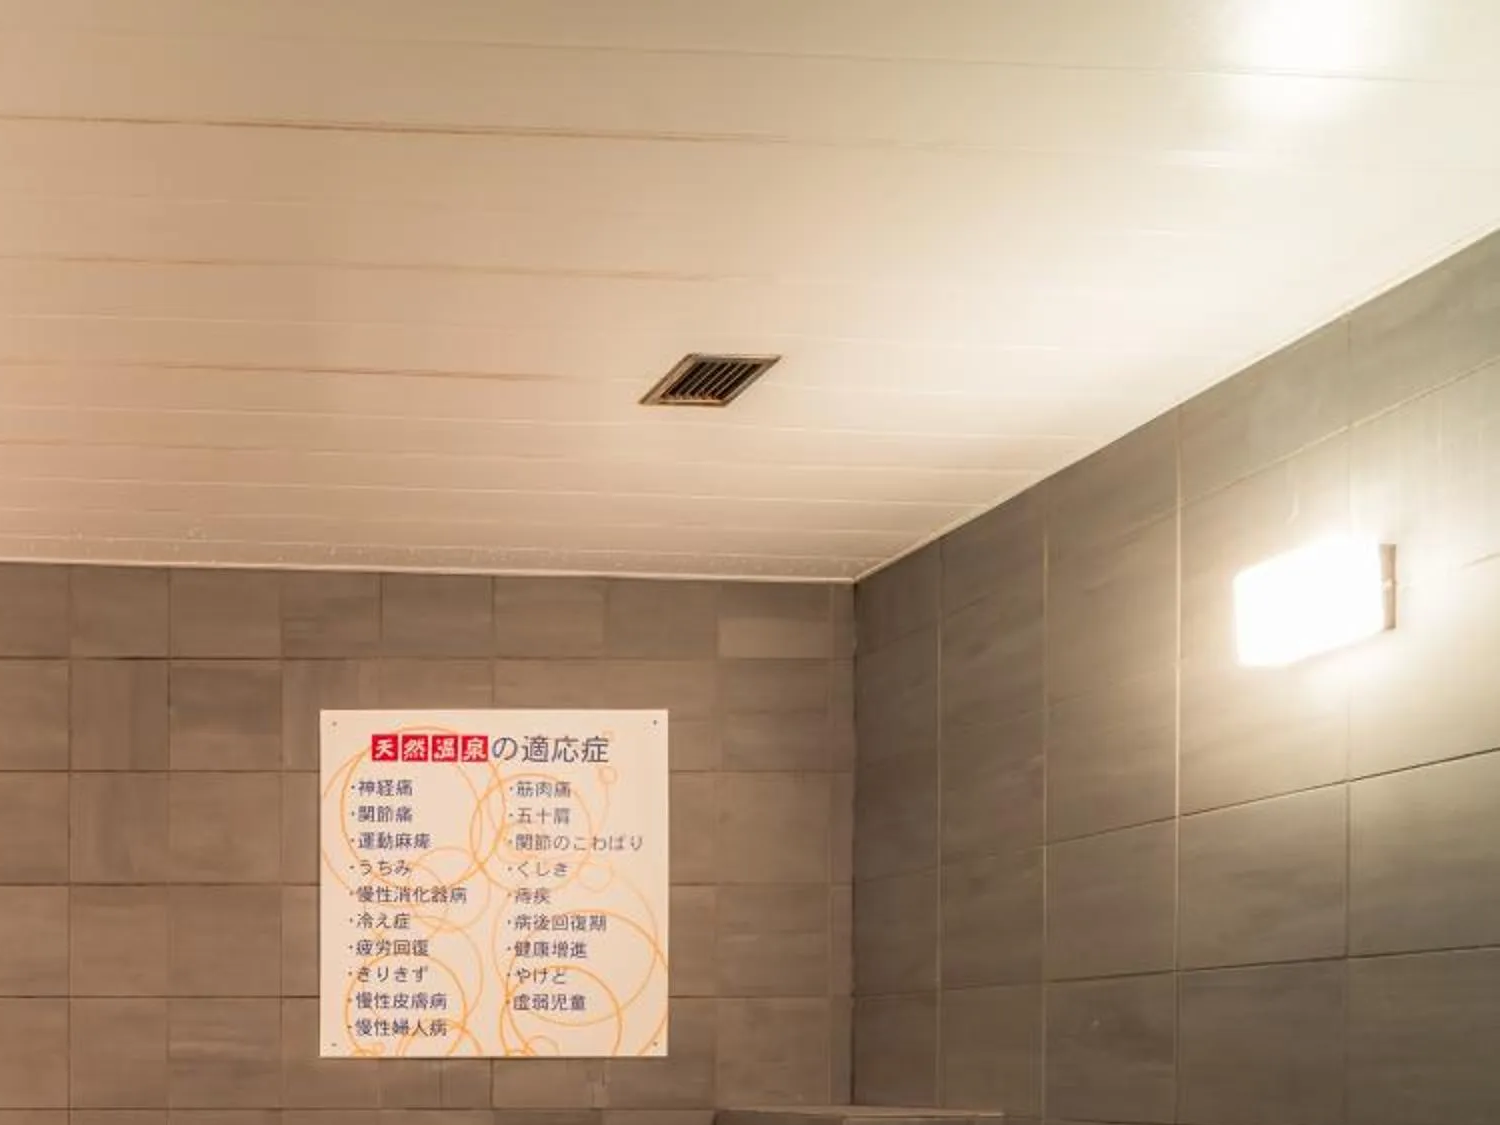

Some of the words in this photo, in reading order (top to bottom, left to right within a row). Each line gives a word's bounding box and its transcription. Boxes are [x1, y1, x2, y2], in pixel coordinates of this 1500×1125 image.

[372, 734, 610, 763] 天然温泉の適応症
[357, 779, 413, 797] 神経痛
[515, 781, 571, 799] 筋肉痛
[357, 806, 413, 823] 関節痛
[516, 808, 571, 825] 五十肩
[515, 833, 643, 851] 関節のこわばり
[359, 859, 411, 877] うちみ
[356, 885, 467, 904] 慢性消化器病
[356, 911, 411, 930] 冷え症
[514, 914, 607, 932] 病後回復期
[355, 939, 429, 957] 疲労回復
[514, 940, 588, 959] 健康増進
[356, 965, 428, 983] きりきず
[516, 967, 567, 985] やけど
[355, 991, 448, 1010] 慢性皮膚病
[513, 993, 587, 1012] 虚弱児童
[355, 1018, 448, 1038] 慢性婦人病
